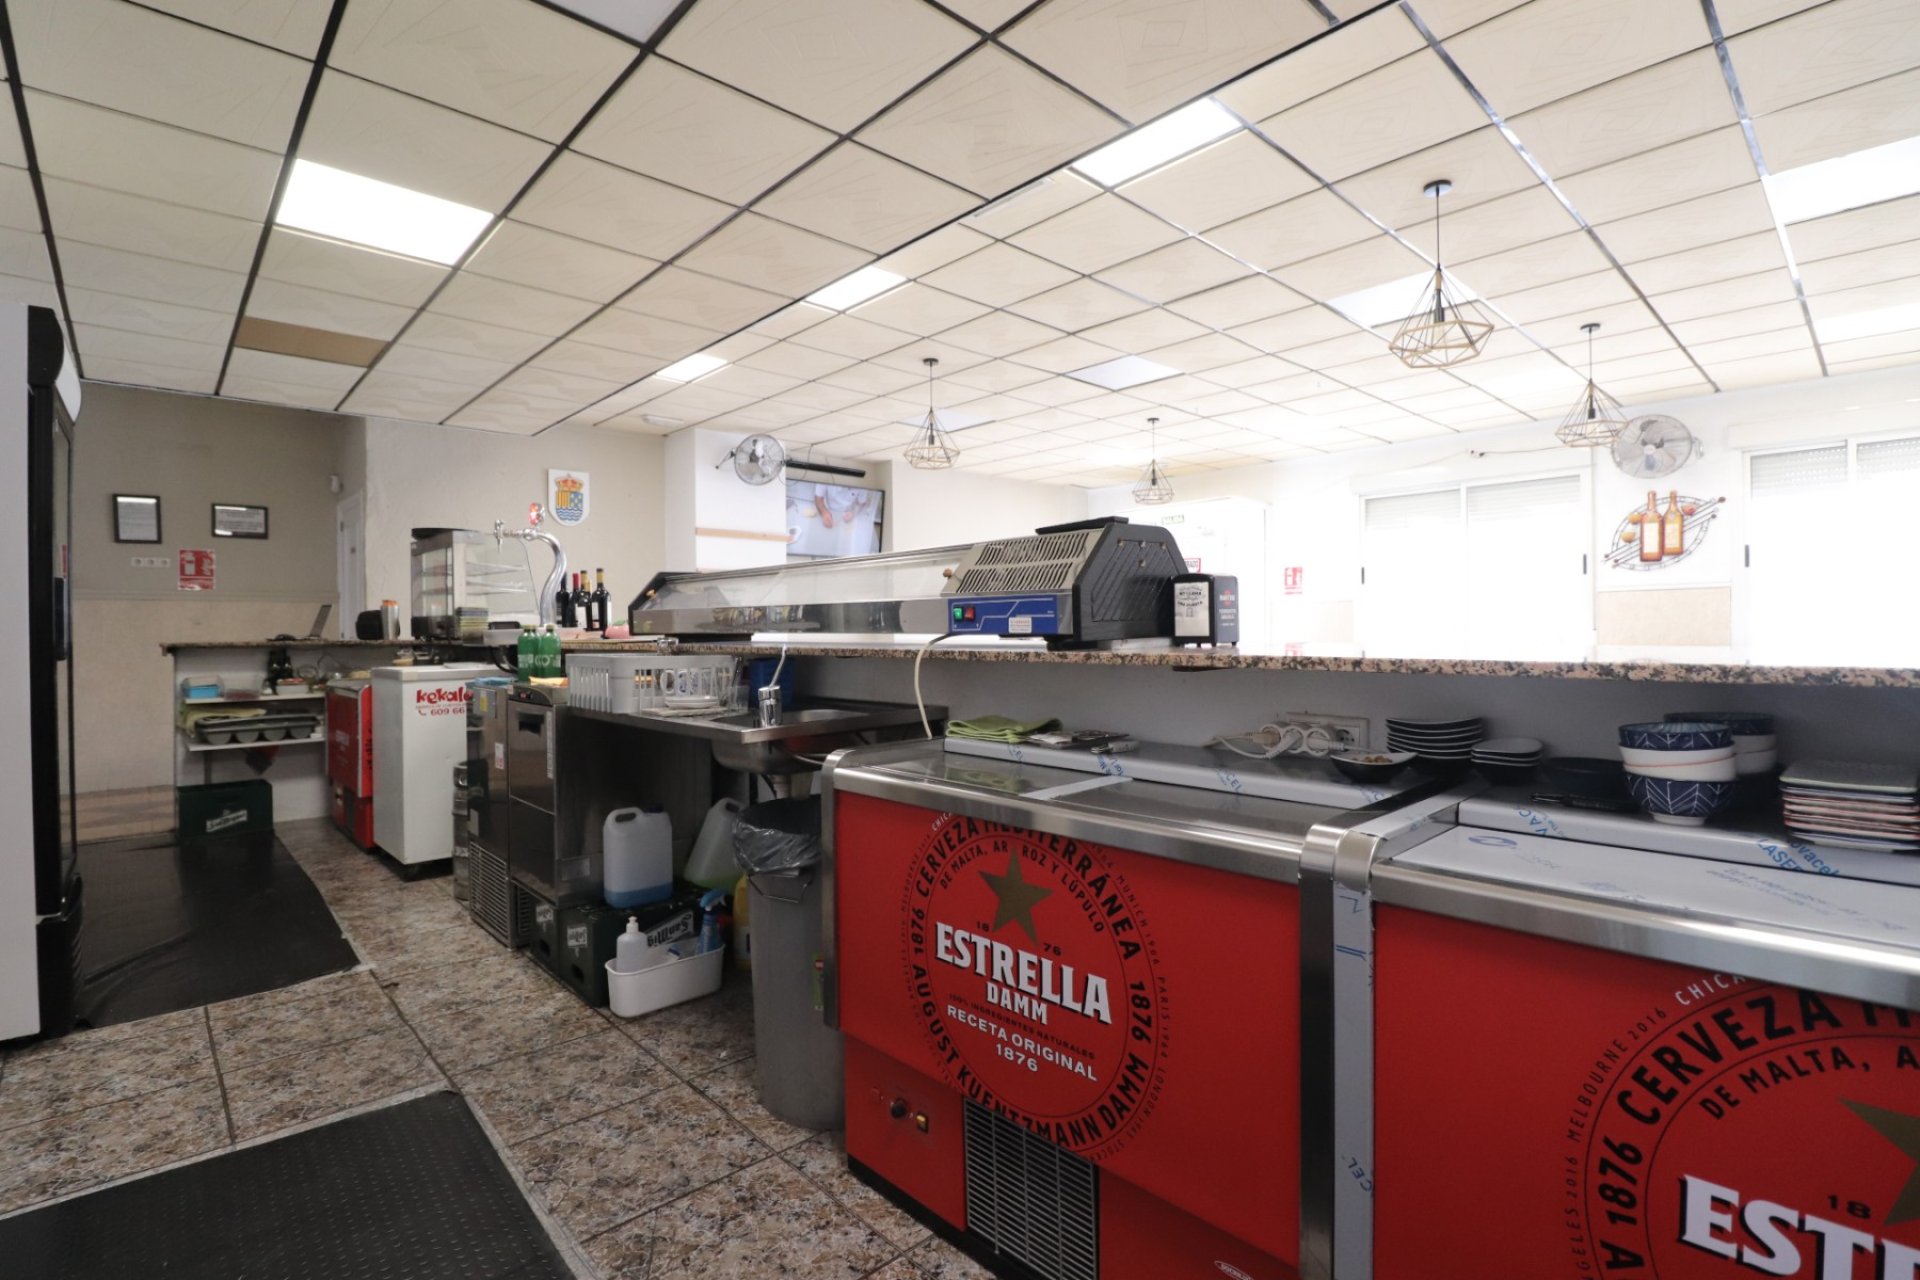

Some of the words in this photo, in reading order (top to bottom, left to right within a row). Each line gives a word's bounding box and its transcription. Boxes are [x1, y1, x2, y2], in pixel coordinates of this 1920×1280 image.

[416, 686, 468, 705] kekal
[430, 708, 450, 717] 609
[452, 706, 466, 716] 66
[916, 816, 980, 898] CERVEZA
[939, 873, 953, 890] DE
[1051, 863, 1060, 875] Y
[1061, 873, 1105, 933] LÚPULO
[911, 907, 926, 955] 1876
[976, 921, 990, 932] 18
[1043, 942, 1062, 956] 76
[935, 921, 1113, 1026] ESTRELLA
[986, 980, 1048, 1025] DAMM
[970, 1001, 1034, 1034] INGREDIENTES
[1036, 1030, 1096, 1060] NATURALES
[1129, 980, 1152, 1044] 1876
[1627, 1007, 1667, 1041] 2016
[912, 963, 960, 1064] AUGUST
[1096, 1051, 1149, 1131] DAMM
[947, 1004, 1008, 1042] RECETA
[1011, 1033, 1098, 1082] ORIGINAL
[996, 1043, 1039, 1073] 1876
[1616, 989, 1844, 1126] CERVEZA
[1567, 1039, 1629, 1143] MELBOURNE
[1698, 1084, 1741, 1120] DE
[1738, 1046, 1871, 1094] MALTA,
[1564, 1156, 1578, 1199] 2016
[1597, 1135, 1644, 1226] 1876
[1827, 1193, 1872, 1220] 18
